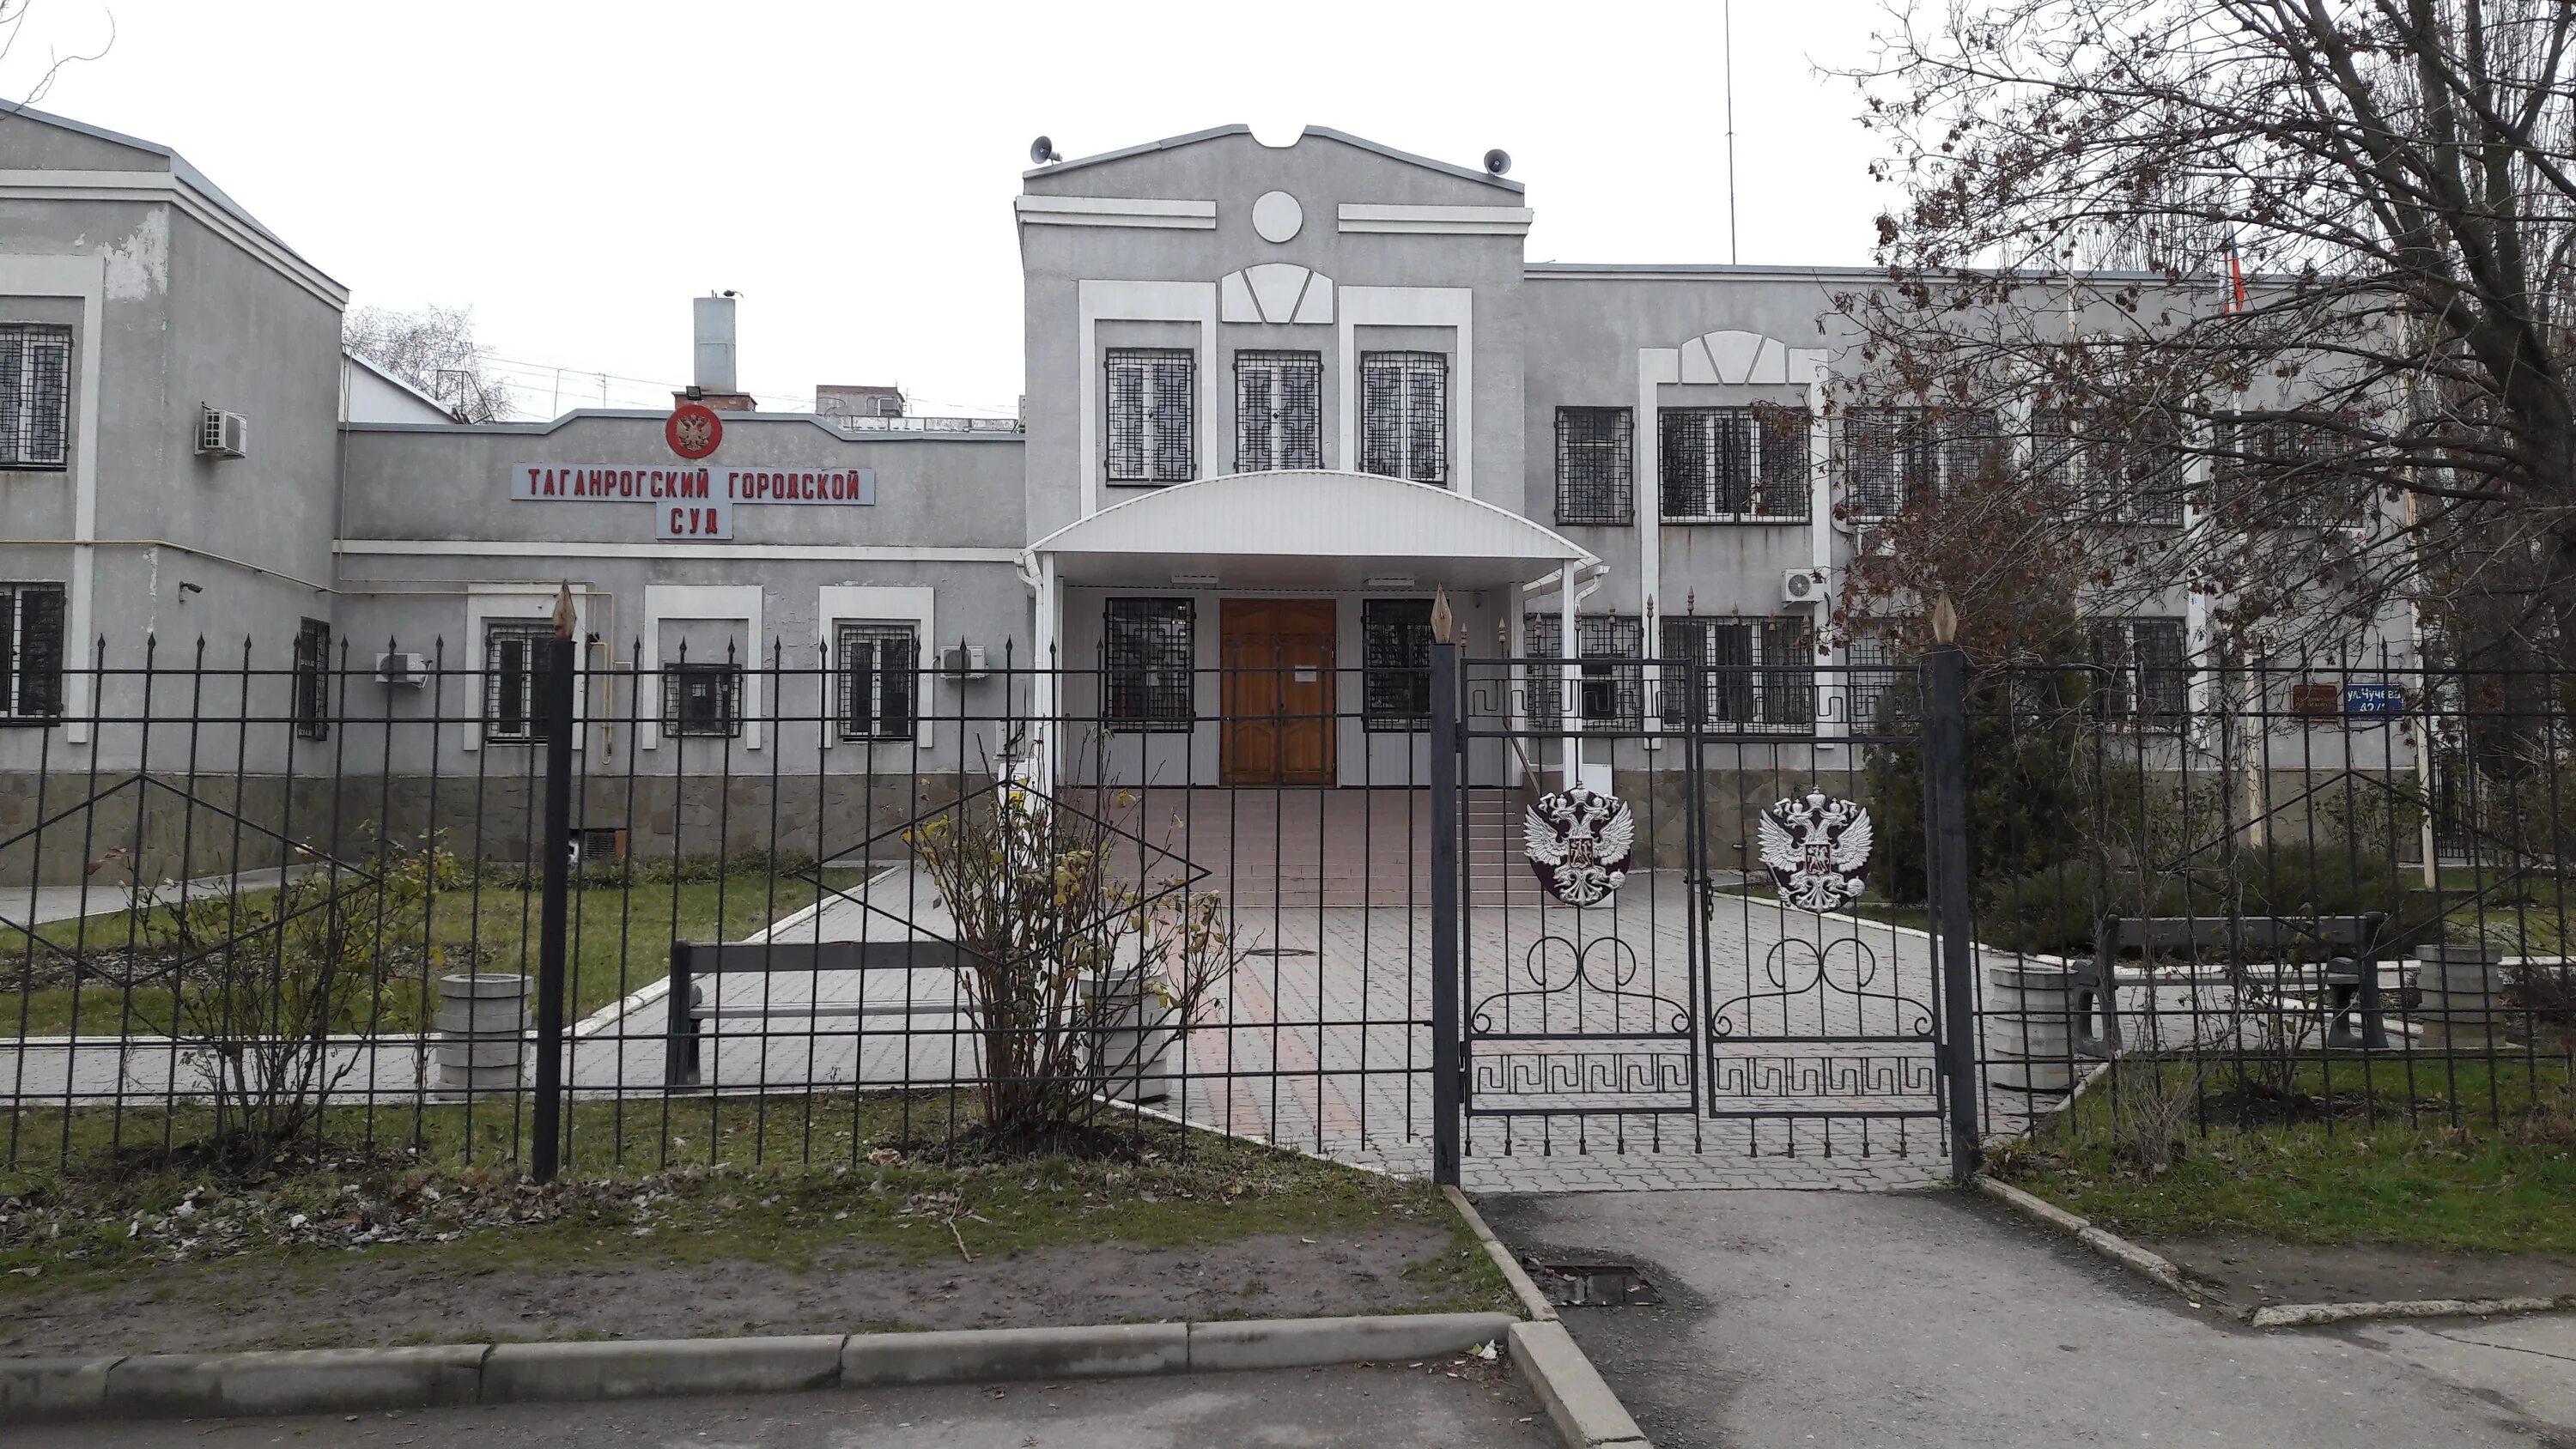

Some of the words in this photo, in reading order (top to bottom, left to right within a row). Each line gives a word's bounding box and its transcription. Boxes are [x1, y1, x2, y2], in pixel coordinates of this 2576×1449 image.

[528, 468, 708, 498] ТАГАНРОГСКИЙ
[728, 470, 859, 500] ГОРОДСКОЙ
[671, 507, 718, 534] СУД
